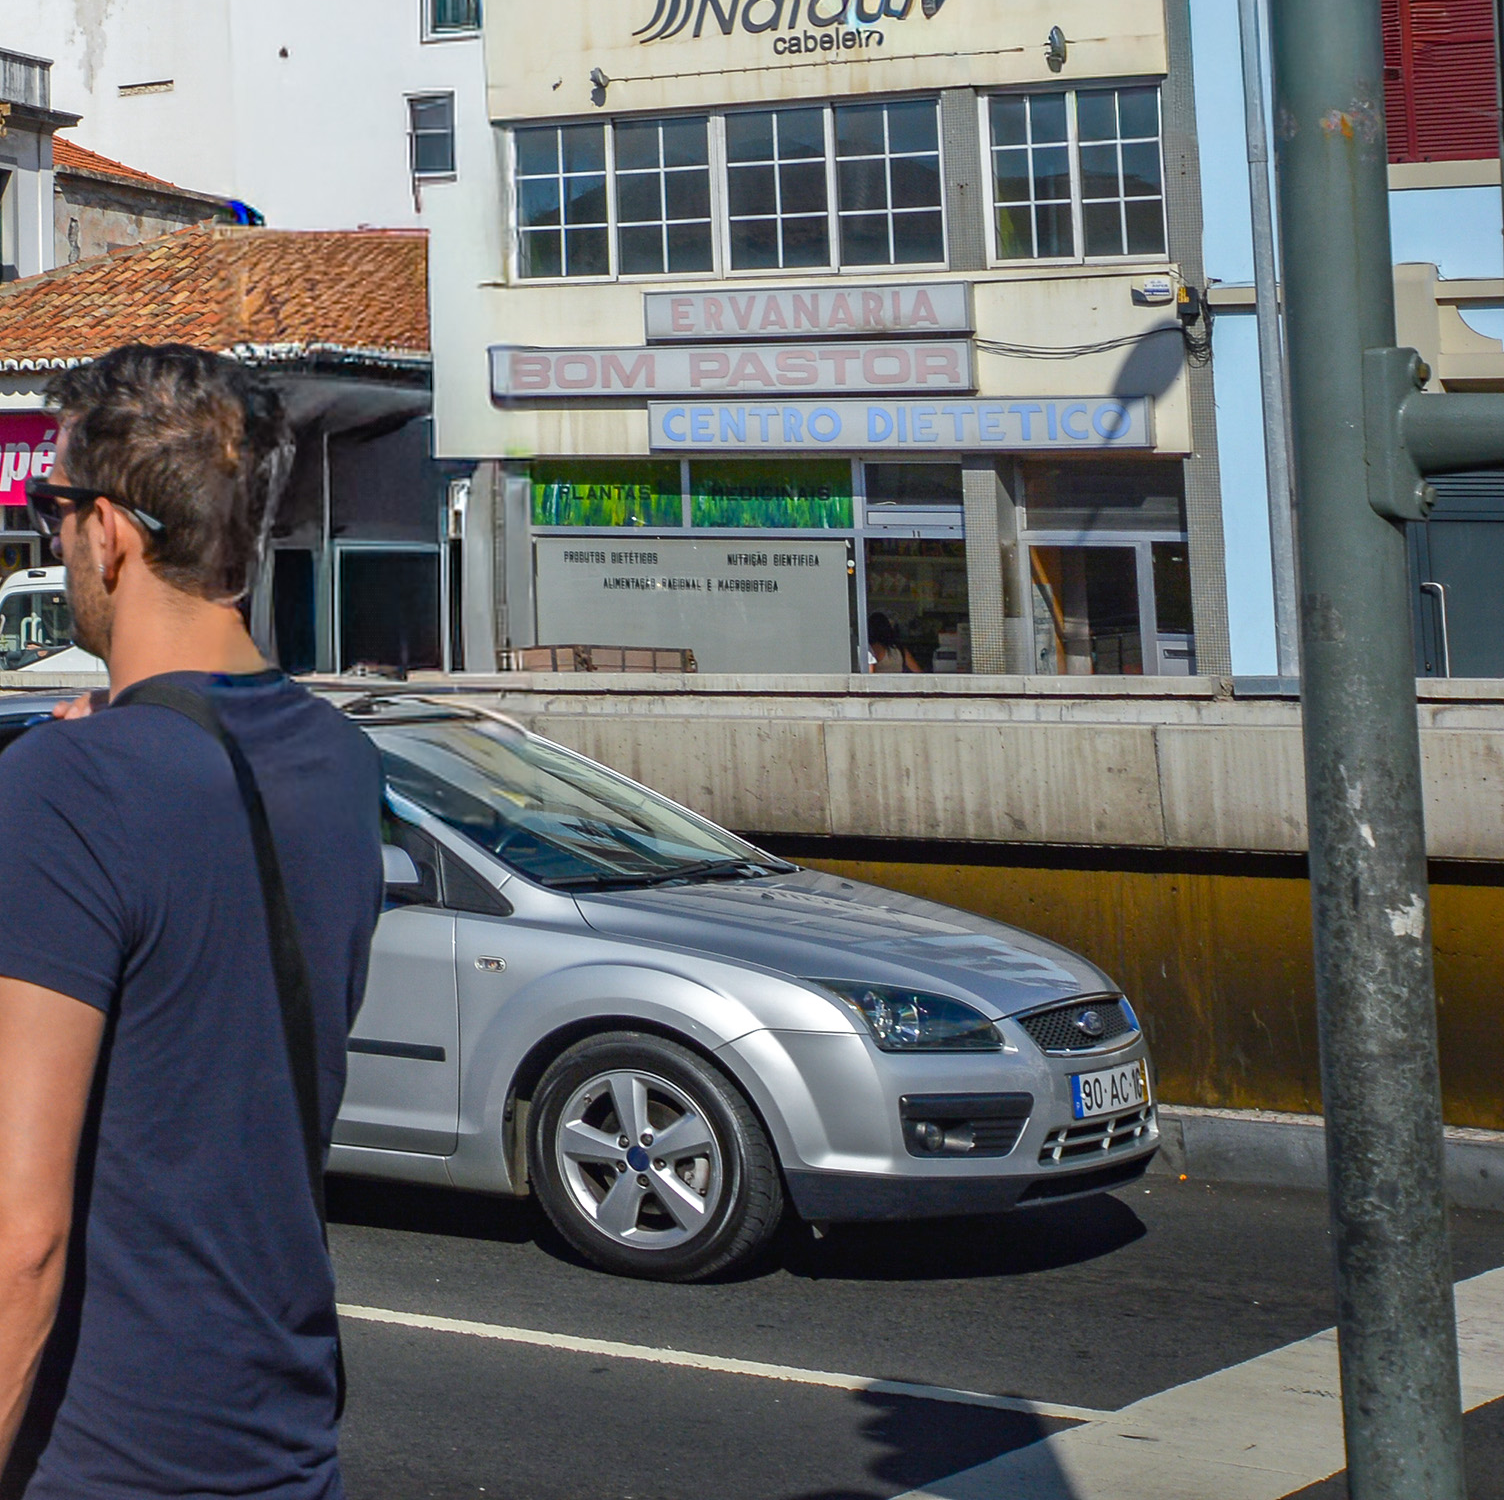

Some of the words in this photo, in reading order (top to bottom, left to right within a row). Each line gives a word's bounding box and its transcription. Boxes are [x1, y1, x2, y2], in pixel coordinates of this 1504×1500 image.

[511, 353, 656, 391] BOM
[689, 347, 962, 388] PASTOR
[661, 405, 842, 443] CENTRO
[867, 402, 1132, 443] DIETETICO
[559, 485, 652, 501] PLANTAS
[711, 484, 831, 502] MEDICINAIS
[564, 550, 606, 565] PRODUTOS
[706, 579, 713, 592] E
